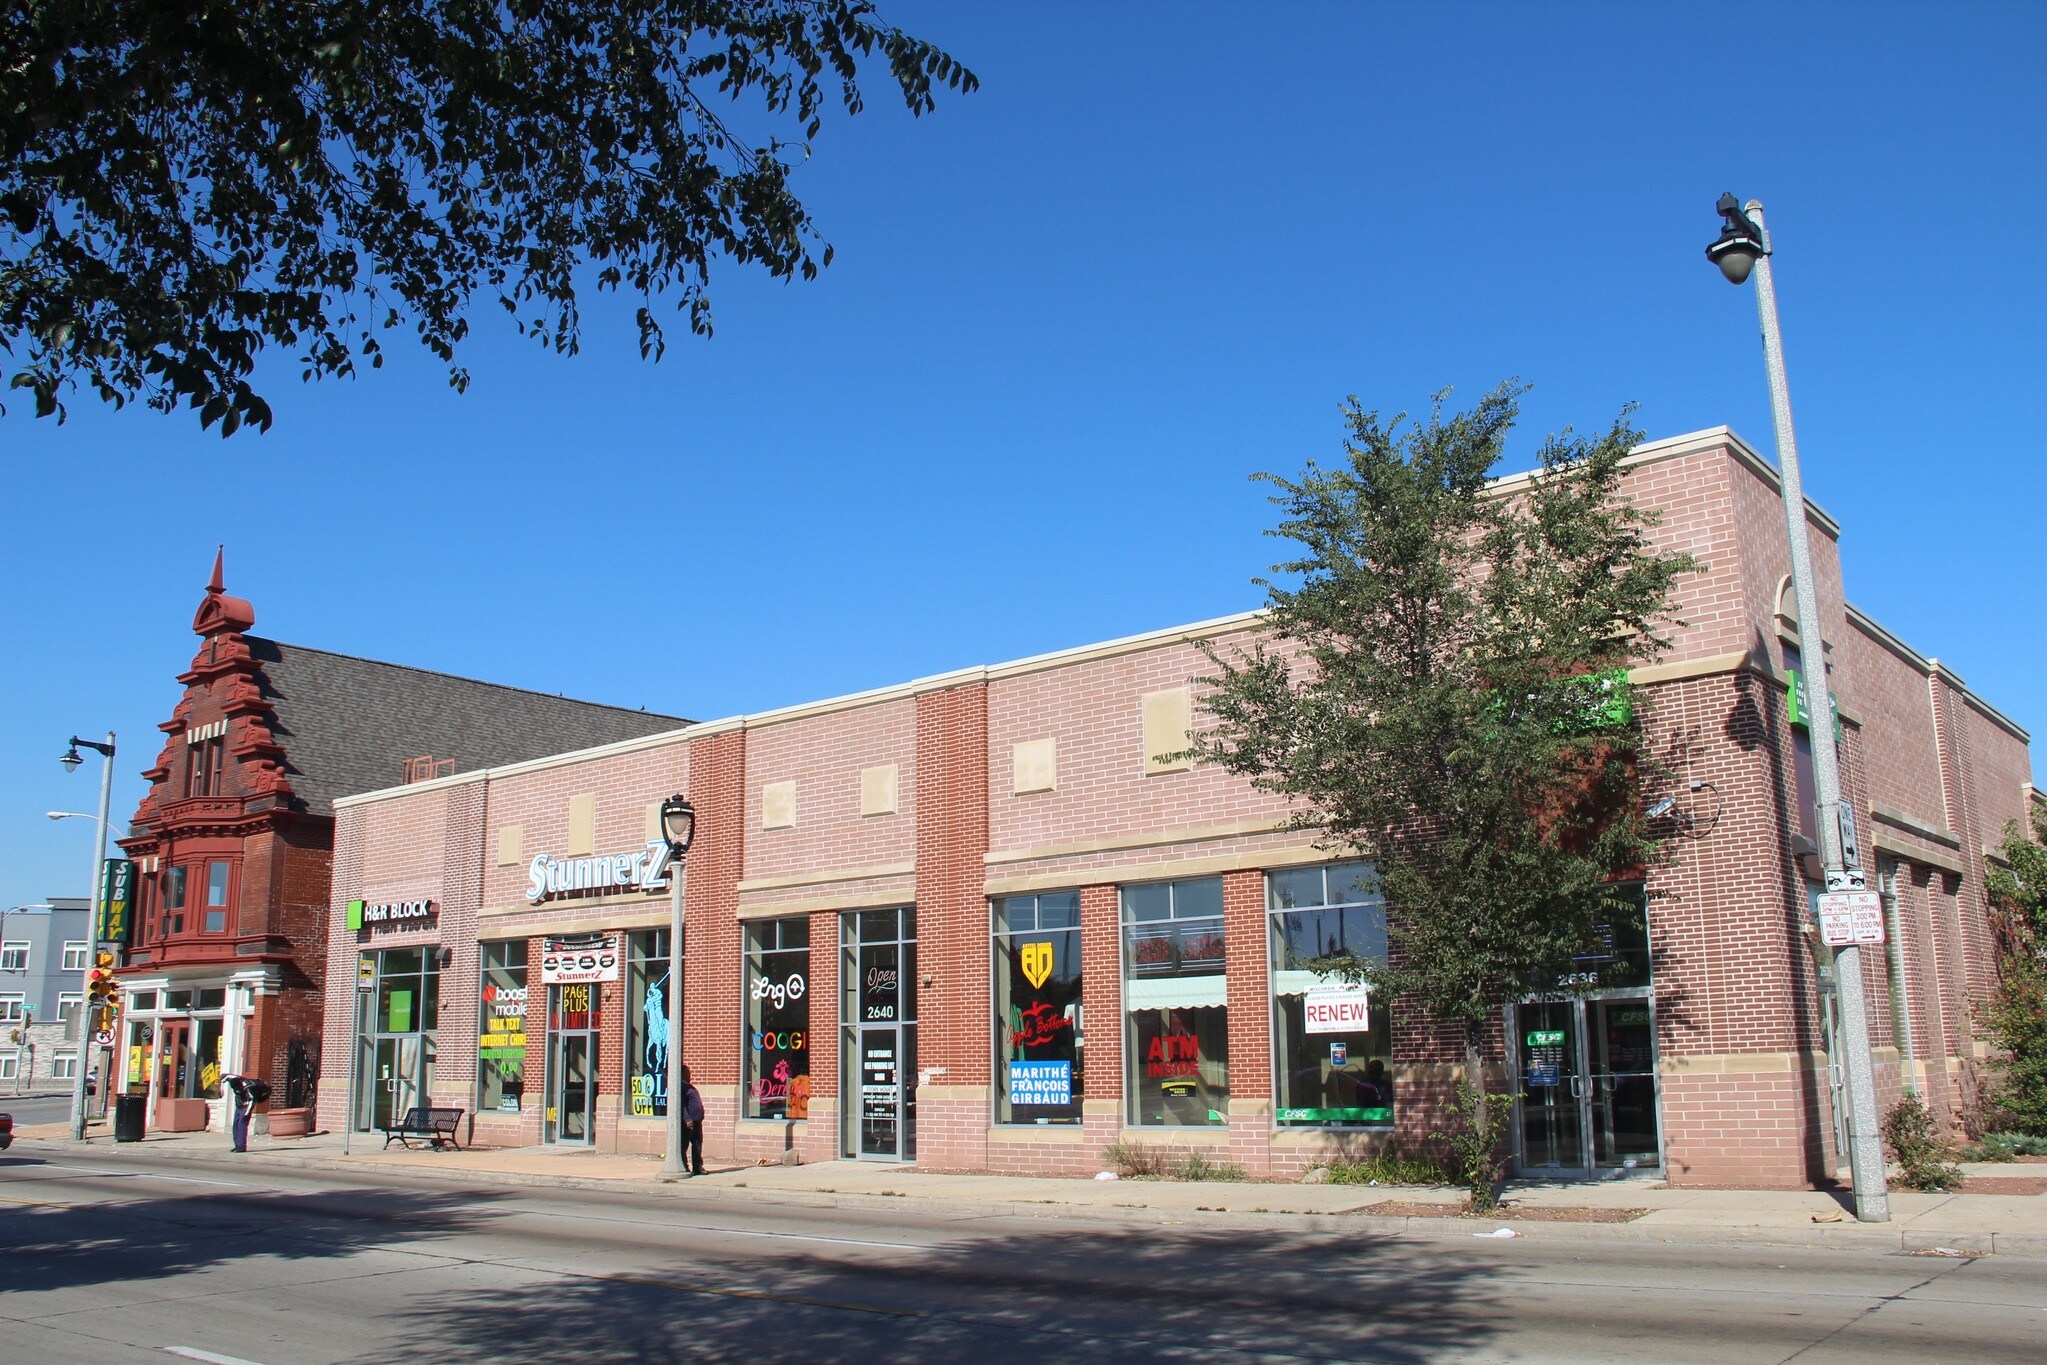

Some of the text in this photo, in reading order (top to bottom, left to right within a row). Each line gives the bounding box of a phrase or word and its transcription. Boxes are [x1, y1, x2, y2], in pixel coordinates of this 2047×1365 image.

[525, 840, 670, 900] StunnerZ
[108, 861, 129, 940] SUBWAY
[364, 900, 428, 922] H&R BLOCK
[555, 970, 602, 980] StunnerZ
[868, 967, 897, 987] Open
[1558, 972, 1598, 986] 2636
[564, 984, 589, 998] PAGE
[563, 998, 588, 1012] PLUS
[868, 1006, 894, 1018] 2640
[1307, 1003, 1364, 1022] RENEW
[490, 1018, 520, 1030] TALK TEXT
[480, 1034, 509, 1046] INTERNET
[752, 1032, 806, 1050] COOGI
[1148, 1035, 1198, 1060] ATM
[1012, 1064, 1068, 1078] MARITHÉ
[1148, 1060, 1200, 1078] INSIDE
[1012, 1080, 1068, 1094] FRANÇOIS
[1012, 1093, 1068, 1104] GIRBAUD
[1284, 1110, 1308, 1118] CFSC
